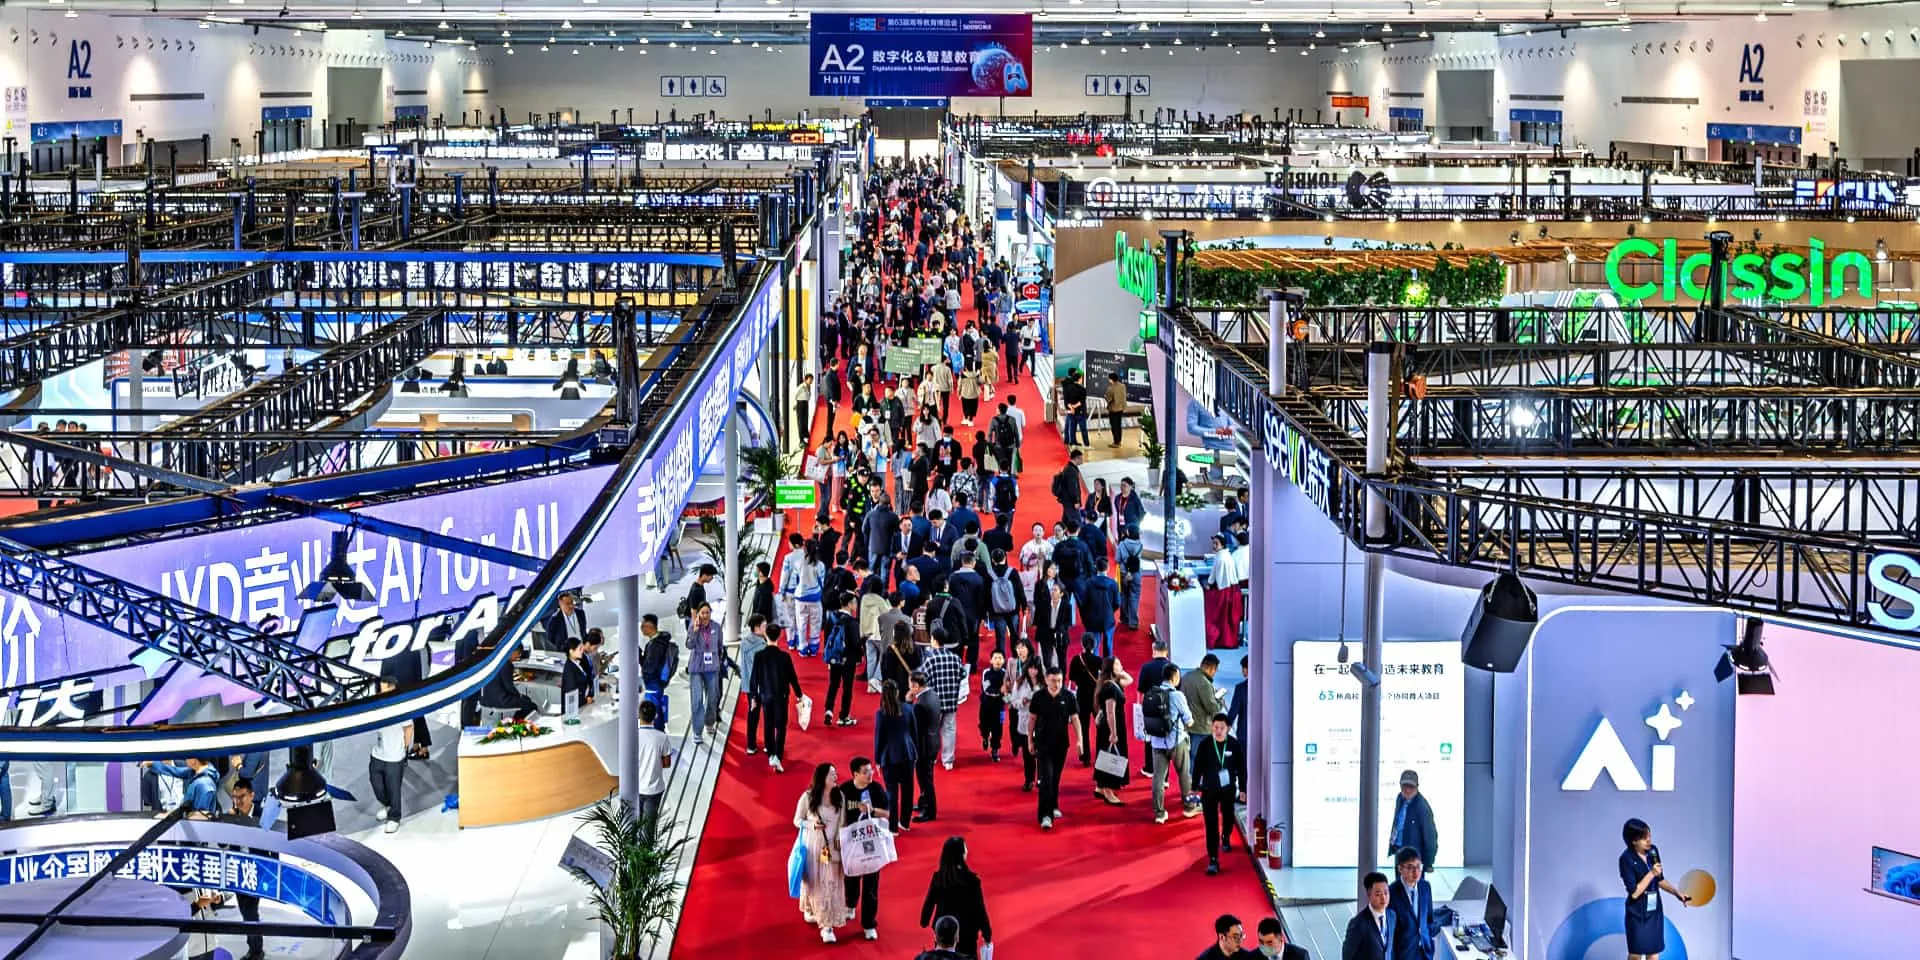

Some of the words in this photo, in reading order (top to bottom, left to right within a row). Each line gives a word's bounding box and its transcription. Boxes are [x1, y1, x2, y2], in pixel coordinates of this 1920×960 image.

[68, 40, 91, 78] A2
[820, 43, 865, 71] A2
[1739, 43, 1764, 83] A2
[436, 516, 496, 595] for
[507, 501, 560, 581] All
[349, 615, 446, 677] for
